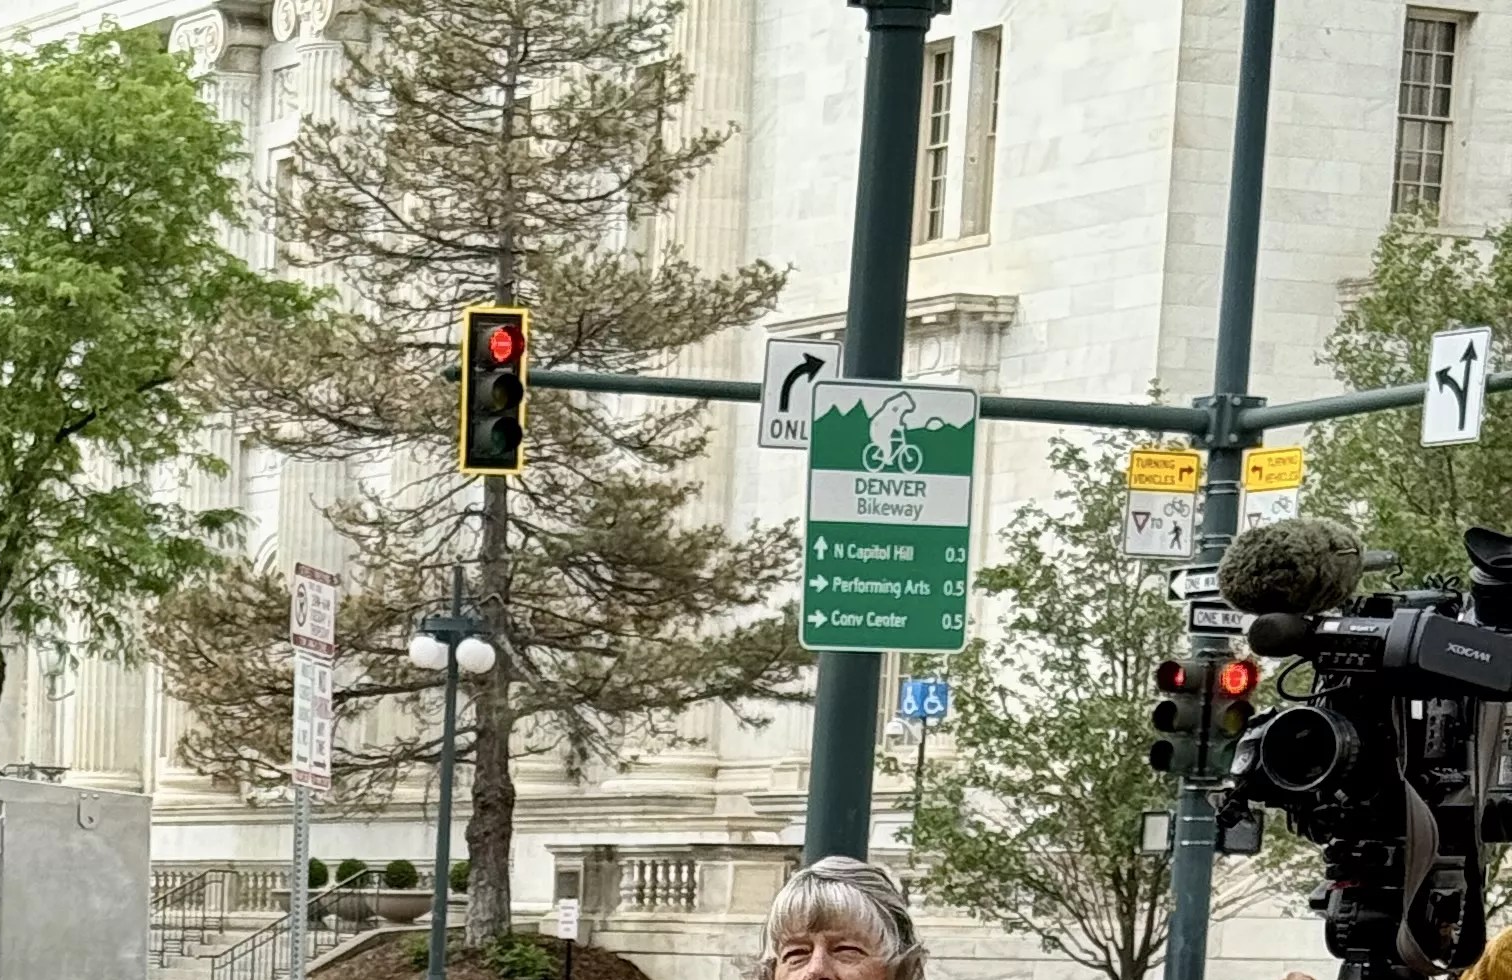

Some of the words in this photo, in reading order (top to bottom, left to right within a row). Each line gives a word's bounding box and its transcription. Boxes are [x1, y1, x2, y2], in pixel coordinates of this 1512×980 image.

[770, 418, 809, 441] ONL
[854, 477, 926, 498] DENVER
[856, 498, 924, 521] Bikeway
[833, 543, 844, 559] N
[847, 543, 891, 564] Capitol
[893, 545, 915, 562] Hill
[944, 547, 967, 563] 0.3
[832, 576, 902, 600] Performing
[904, 579, 931, 596] Arts
[943, 580, 965, 597] 0.5
[830, 608, 863, 628] Conv
[866, 611, 908, 629] Center
[941, 613, 963, 630] 0.5
